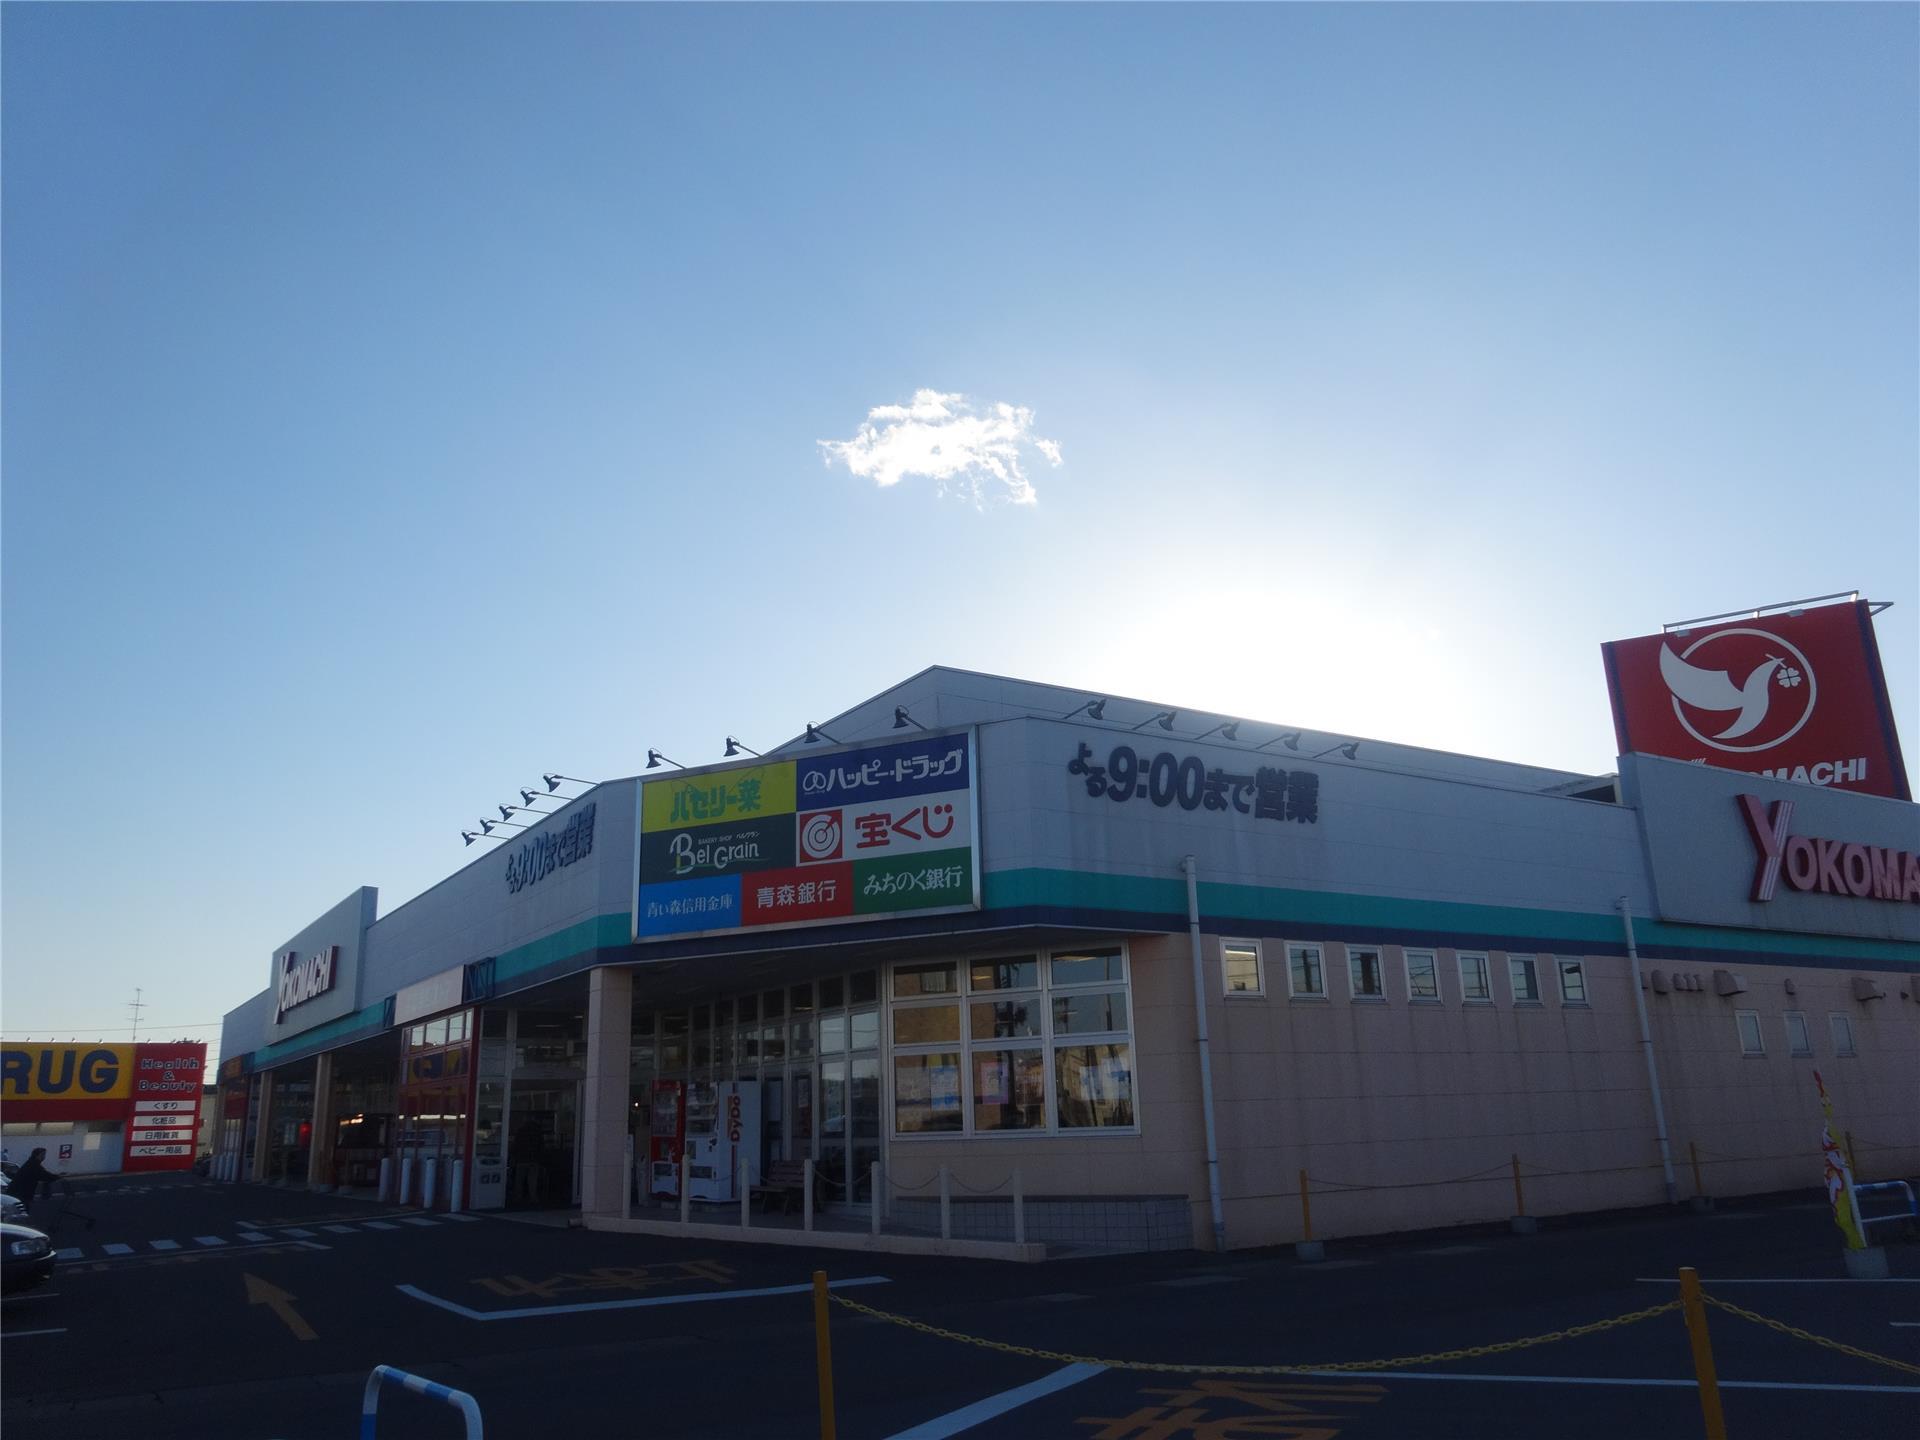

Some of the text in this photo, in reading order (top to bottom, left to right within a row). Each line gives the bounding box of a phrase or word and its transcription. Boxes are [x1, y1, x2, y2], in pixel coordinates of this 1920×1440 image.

[1068, 742, 1319, 824] よる9:00まで営業
[671, 778, 762, 823] パセリー菜
[855, 804, 956, 849] 宝くじ
[670, 833, 760, 875] Bel Grain
[756, 879, 837, 909] 青森銀行
[863, 865, 965, 896] みちのく銀行
[647, 893, 734, 918] 青い森信用金庫
[273, 946, 339, 1025] YOKOMACHI
[0, 1050, 120, 1094] RUG
[141, 1057, 200, 1070] Health
[162, 1070, 176, 1081] &
[138, 1080, 196, 1093] Beauty
[151, 1116, 177, 1125] 化粧品
[153, 1102, 178, 1110] くすり
